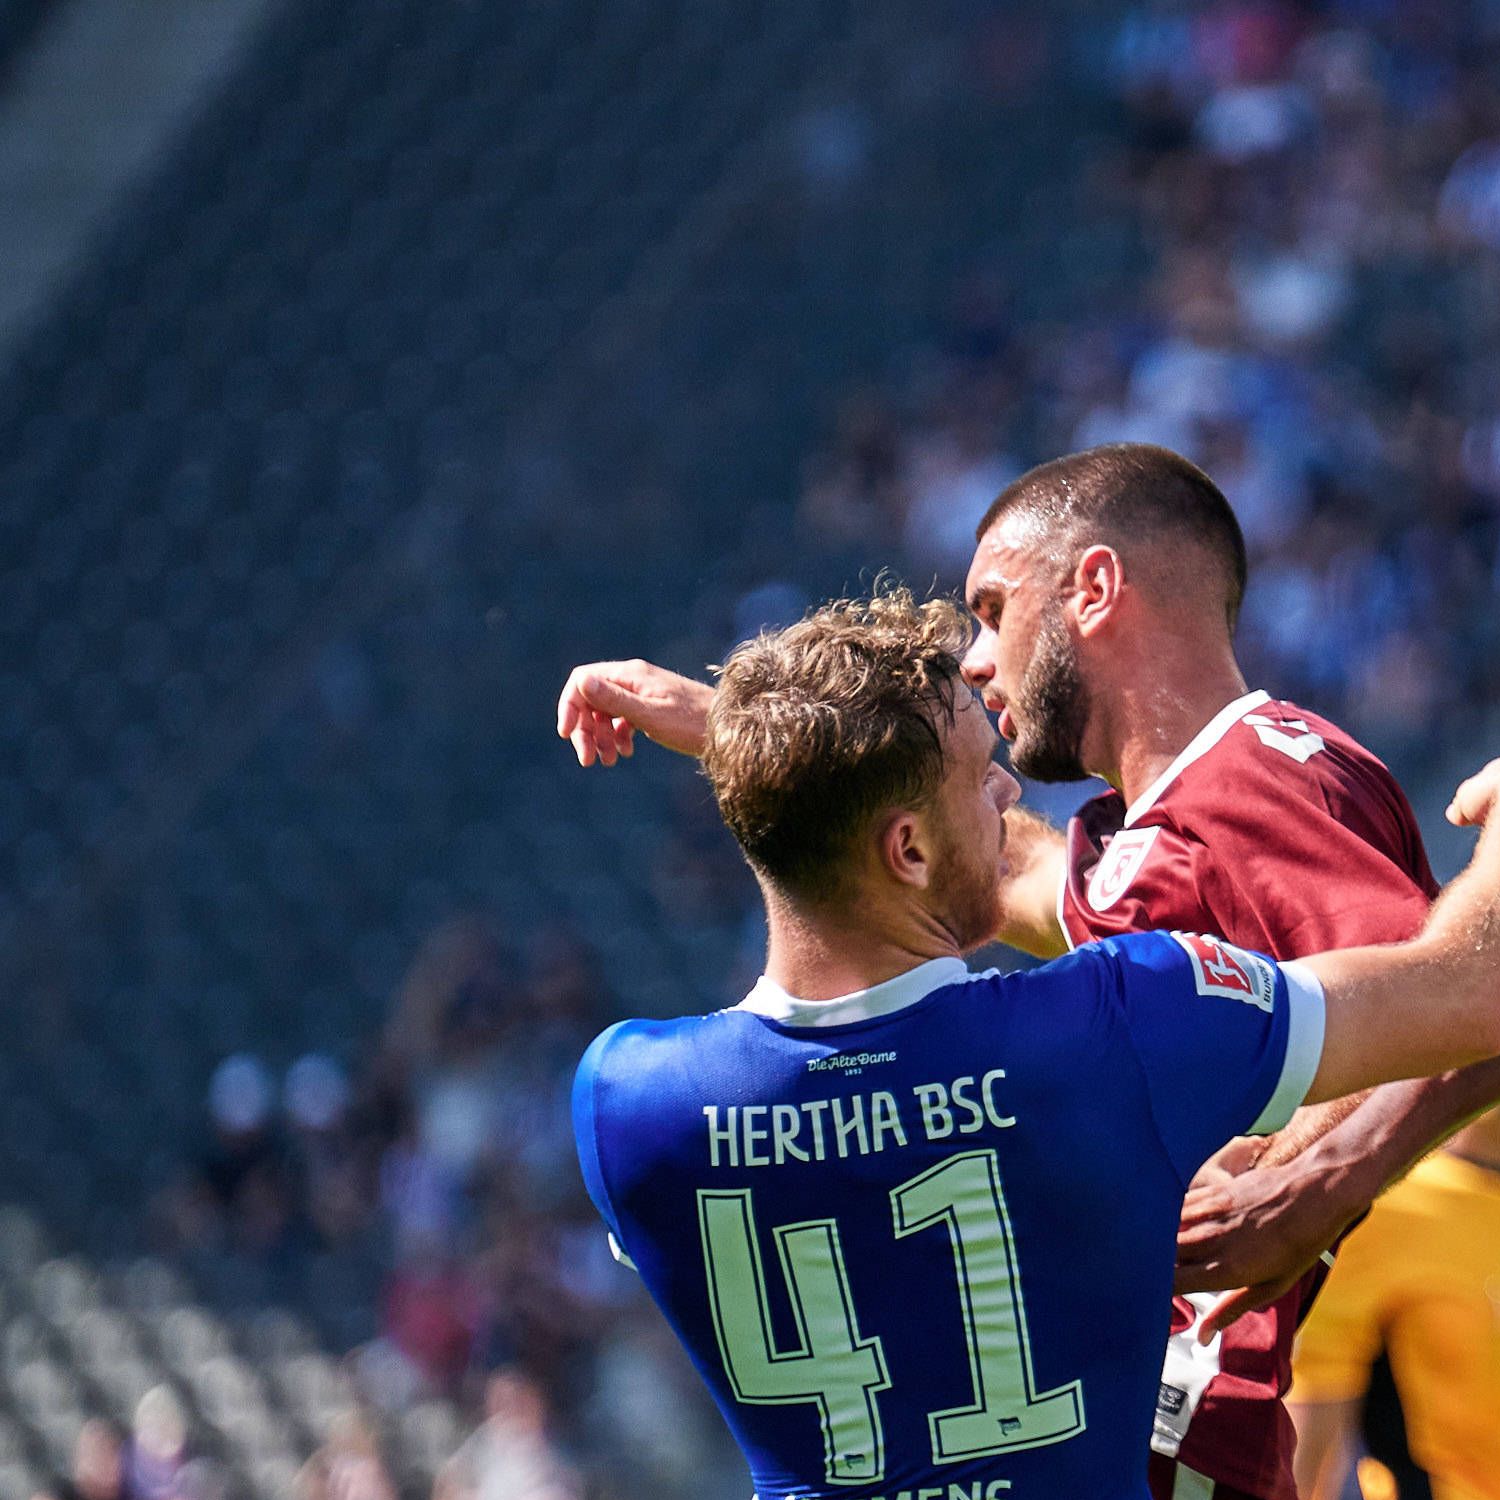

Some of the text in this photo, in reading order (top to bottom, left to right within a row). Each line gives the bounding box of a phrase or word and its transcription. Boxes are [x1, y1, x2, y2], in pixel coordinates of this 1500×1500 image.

[703, 1069, 1017, 1167] HERTHA BSC
[696, 1148, 1087, 1485] 41
